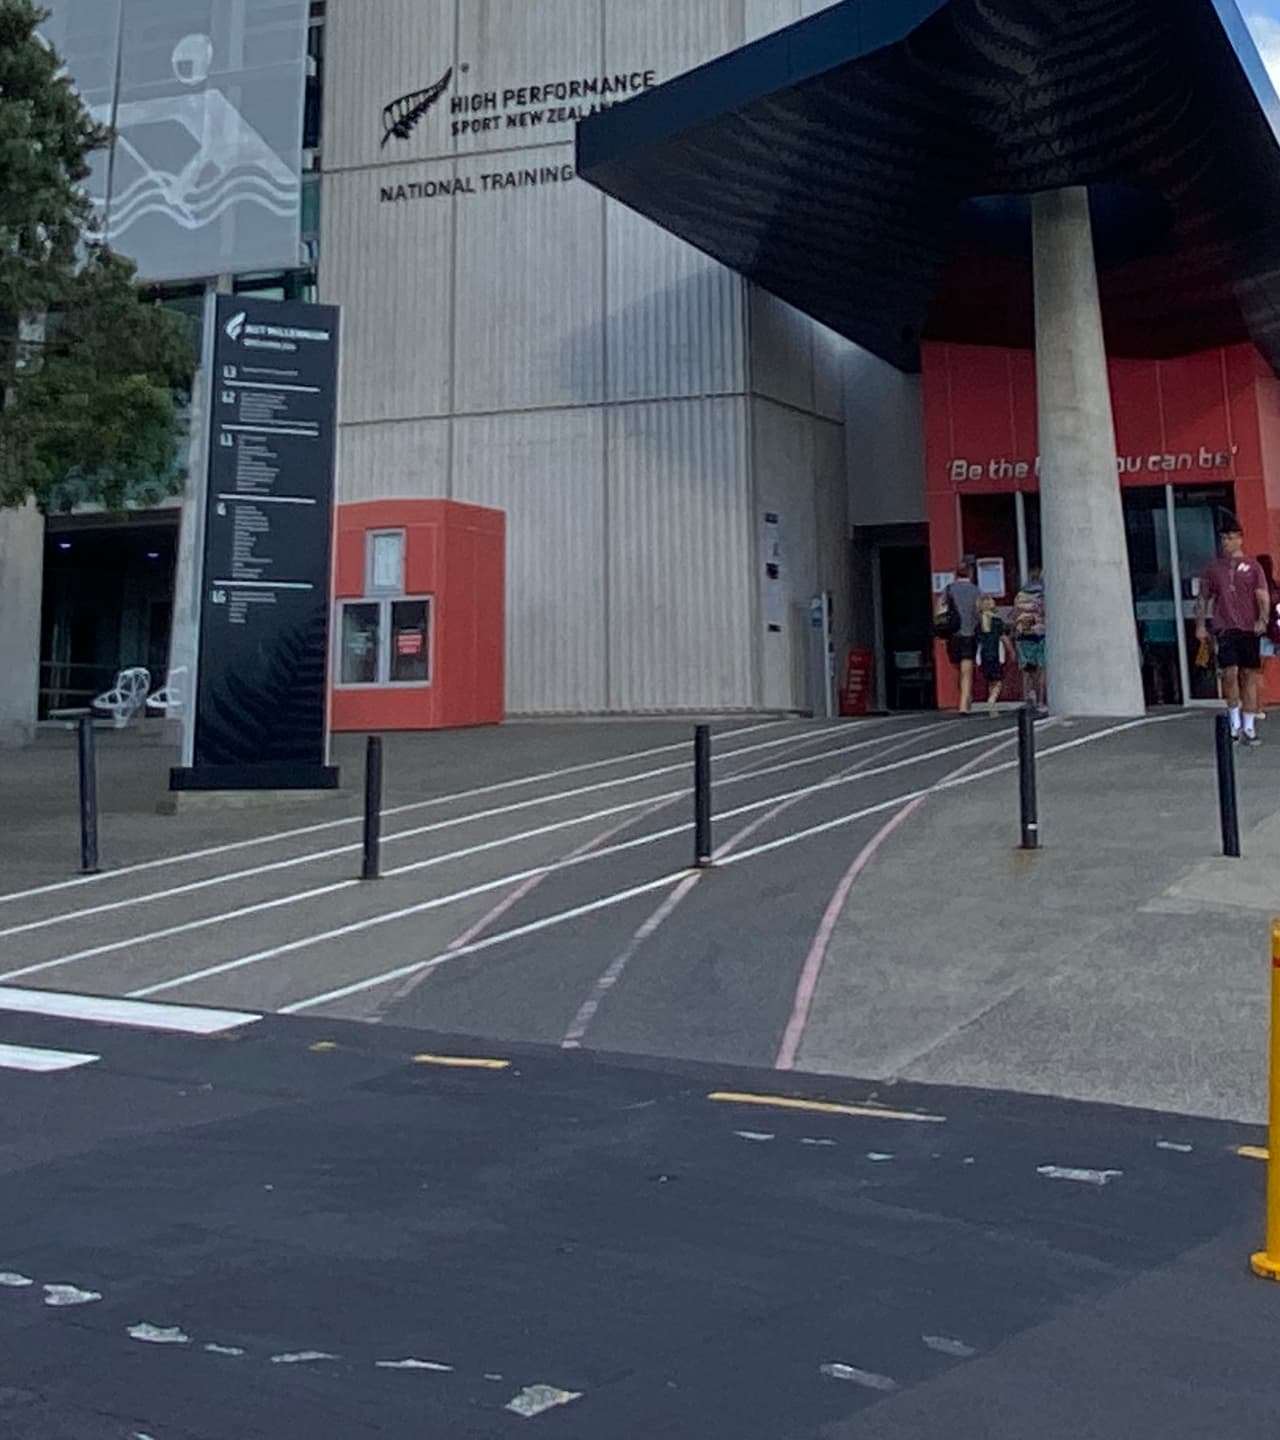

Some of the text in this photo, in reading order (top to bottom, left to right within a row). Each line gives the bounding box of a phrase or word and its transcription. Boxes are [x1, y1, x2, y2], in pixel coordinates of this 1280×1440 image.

[450, 70, 657, 115] HIGH PERFORMANCE
[451, 116, 501, 137] SPORT
[506, 110, 544, 129] NEW
[380, 164, 575, 203] NATIONAL TRAINING
[988, 458, 1029, 480] the
[1147, 453, 1193, 472] can
